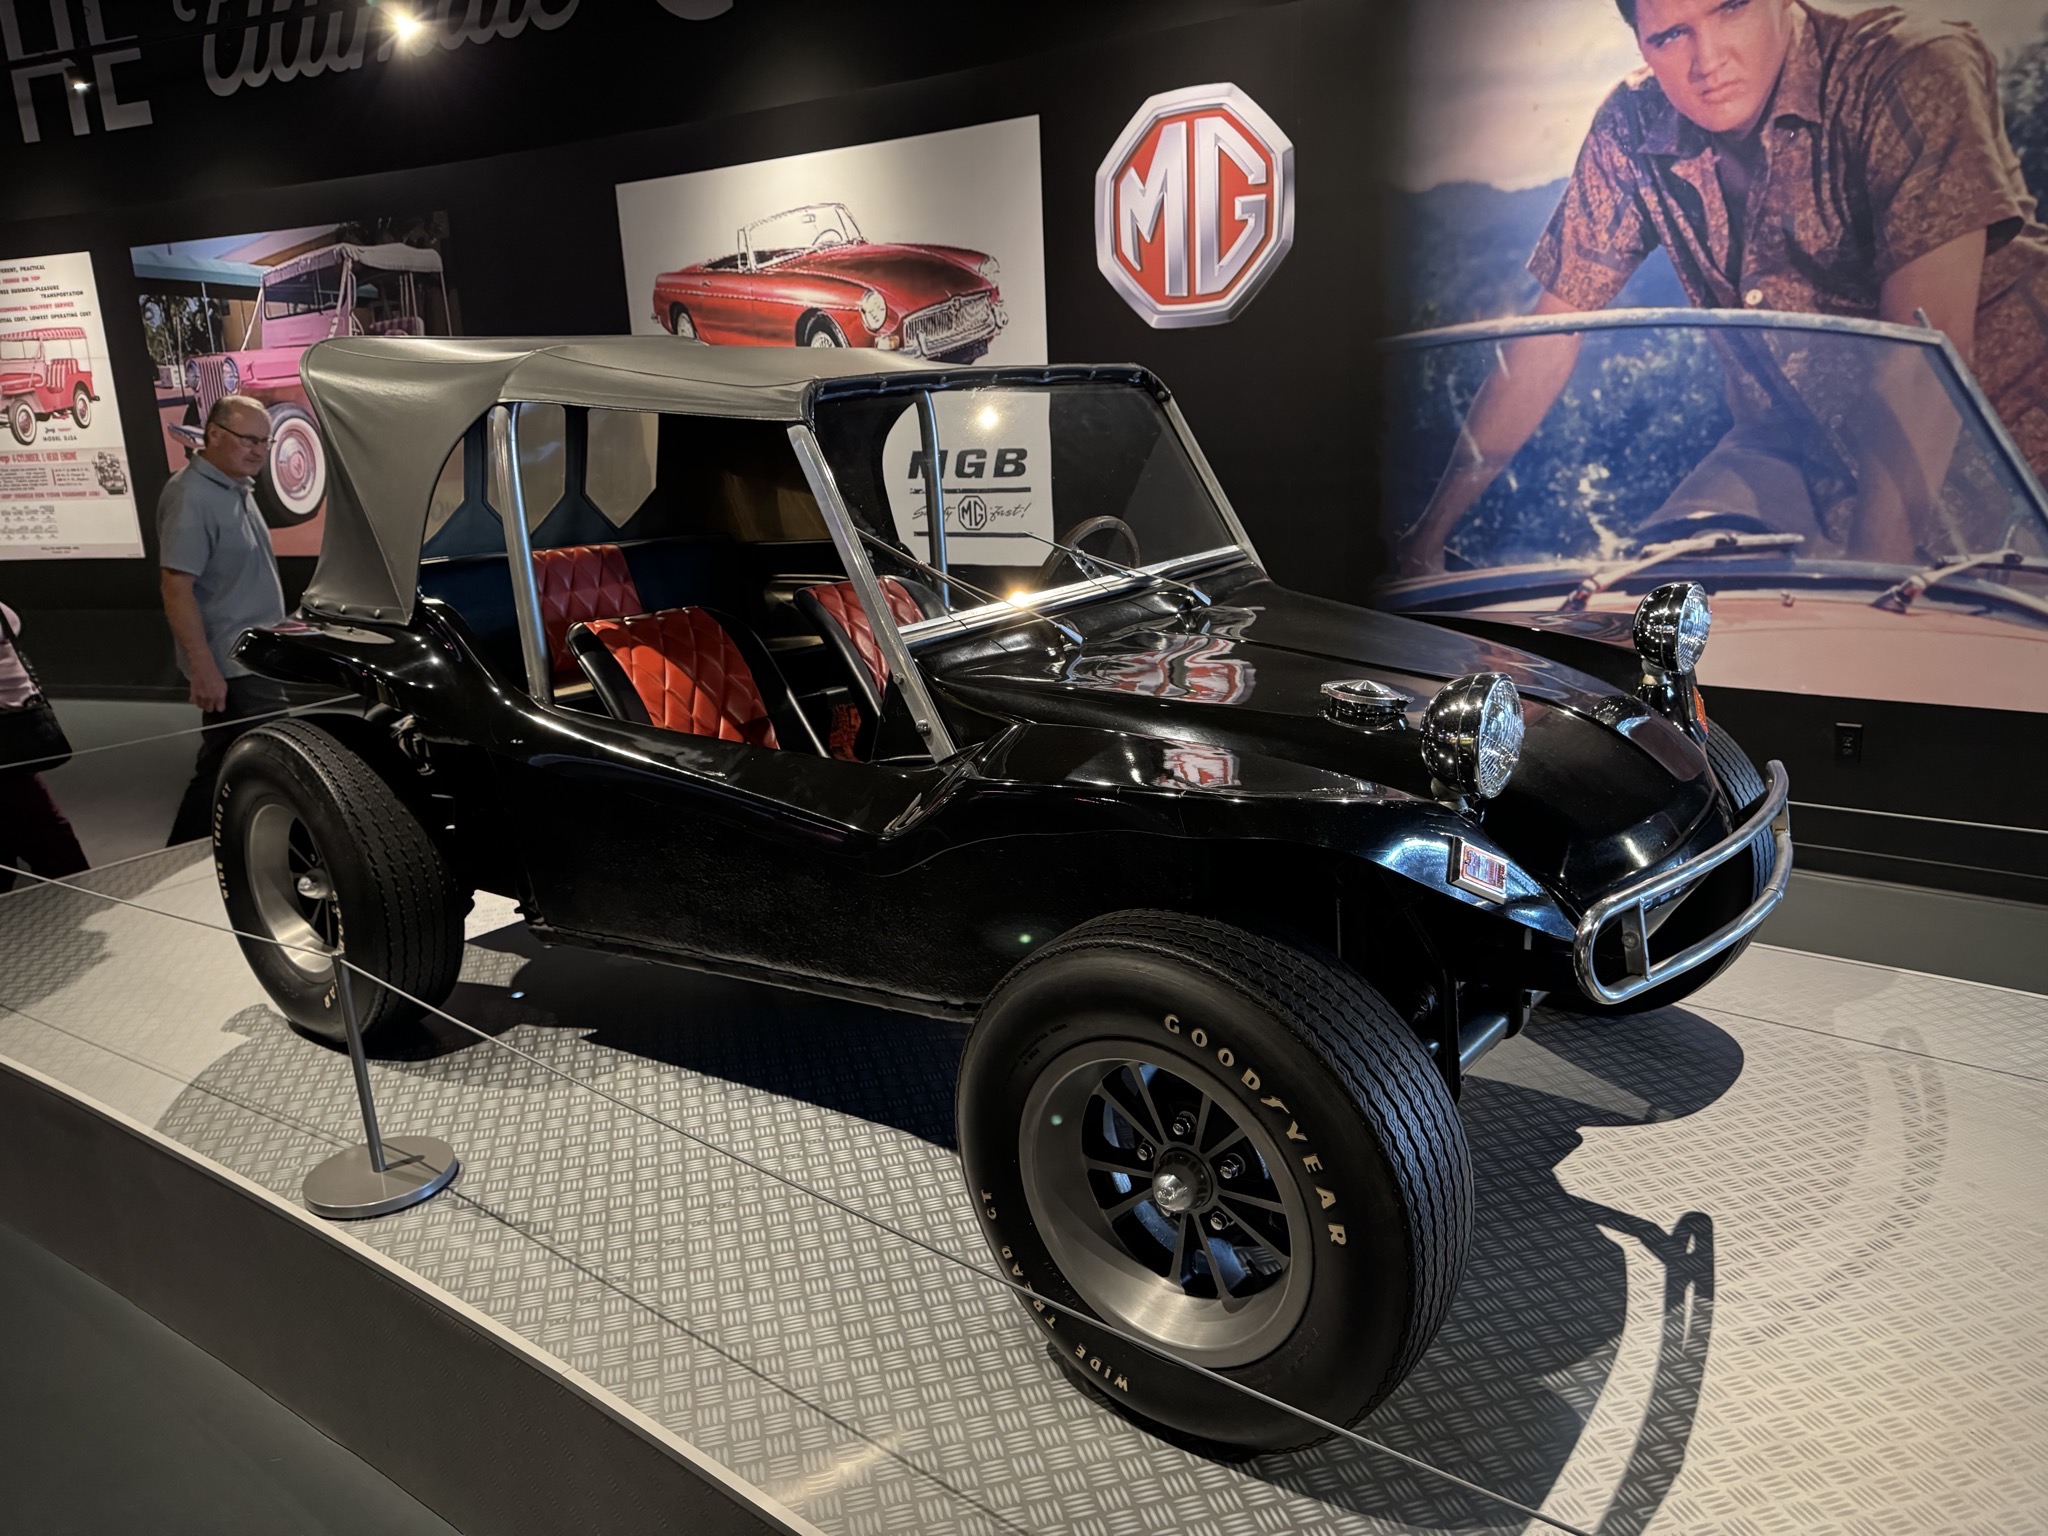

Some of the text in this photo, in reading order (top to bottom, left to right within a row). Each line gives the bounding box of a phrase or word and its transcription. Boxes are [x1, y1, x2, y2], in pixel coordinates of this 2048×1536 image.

[1119, 116, 1267, 297] MG
[907, 448, 1028, 479] MGB
[961, 500, 985, 527] MG
[1164, 1013, 1347, 1246] GOODYEAR
[981, 1189, 1128, 1392] WIDE TREAD GT
